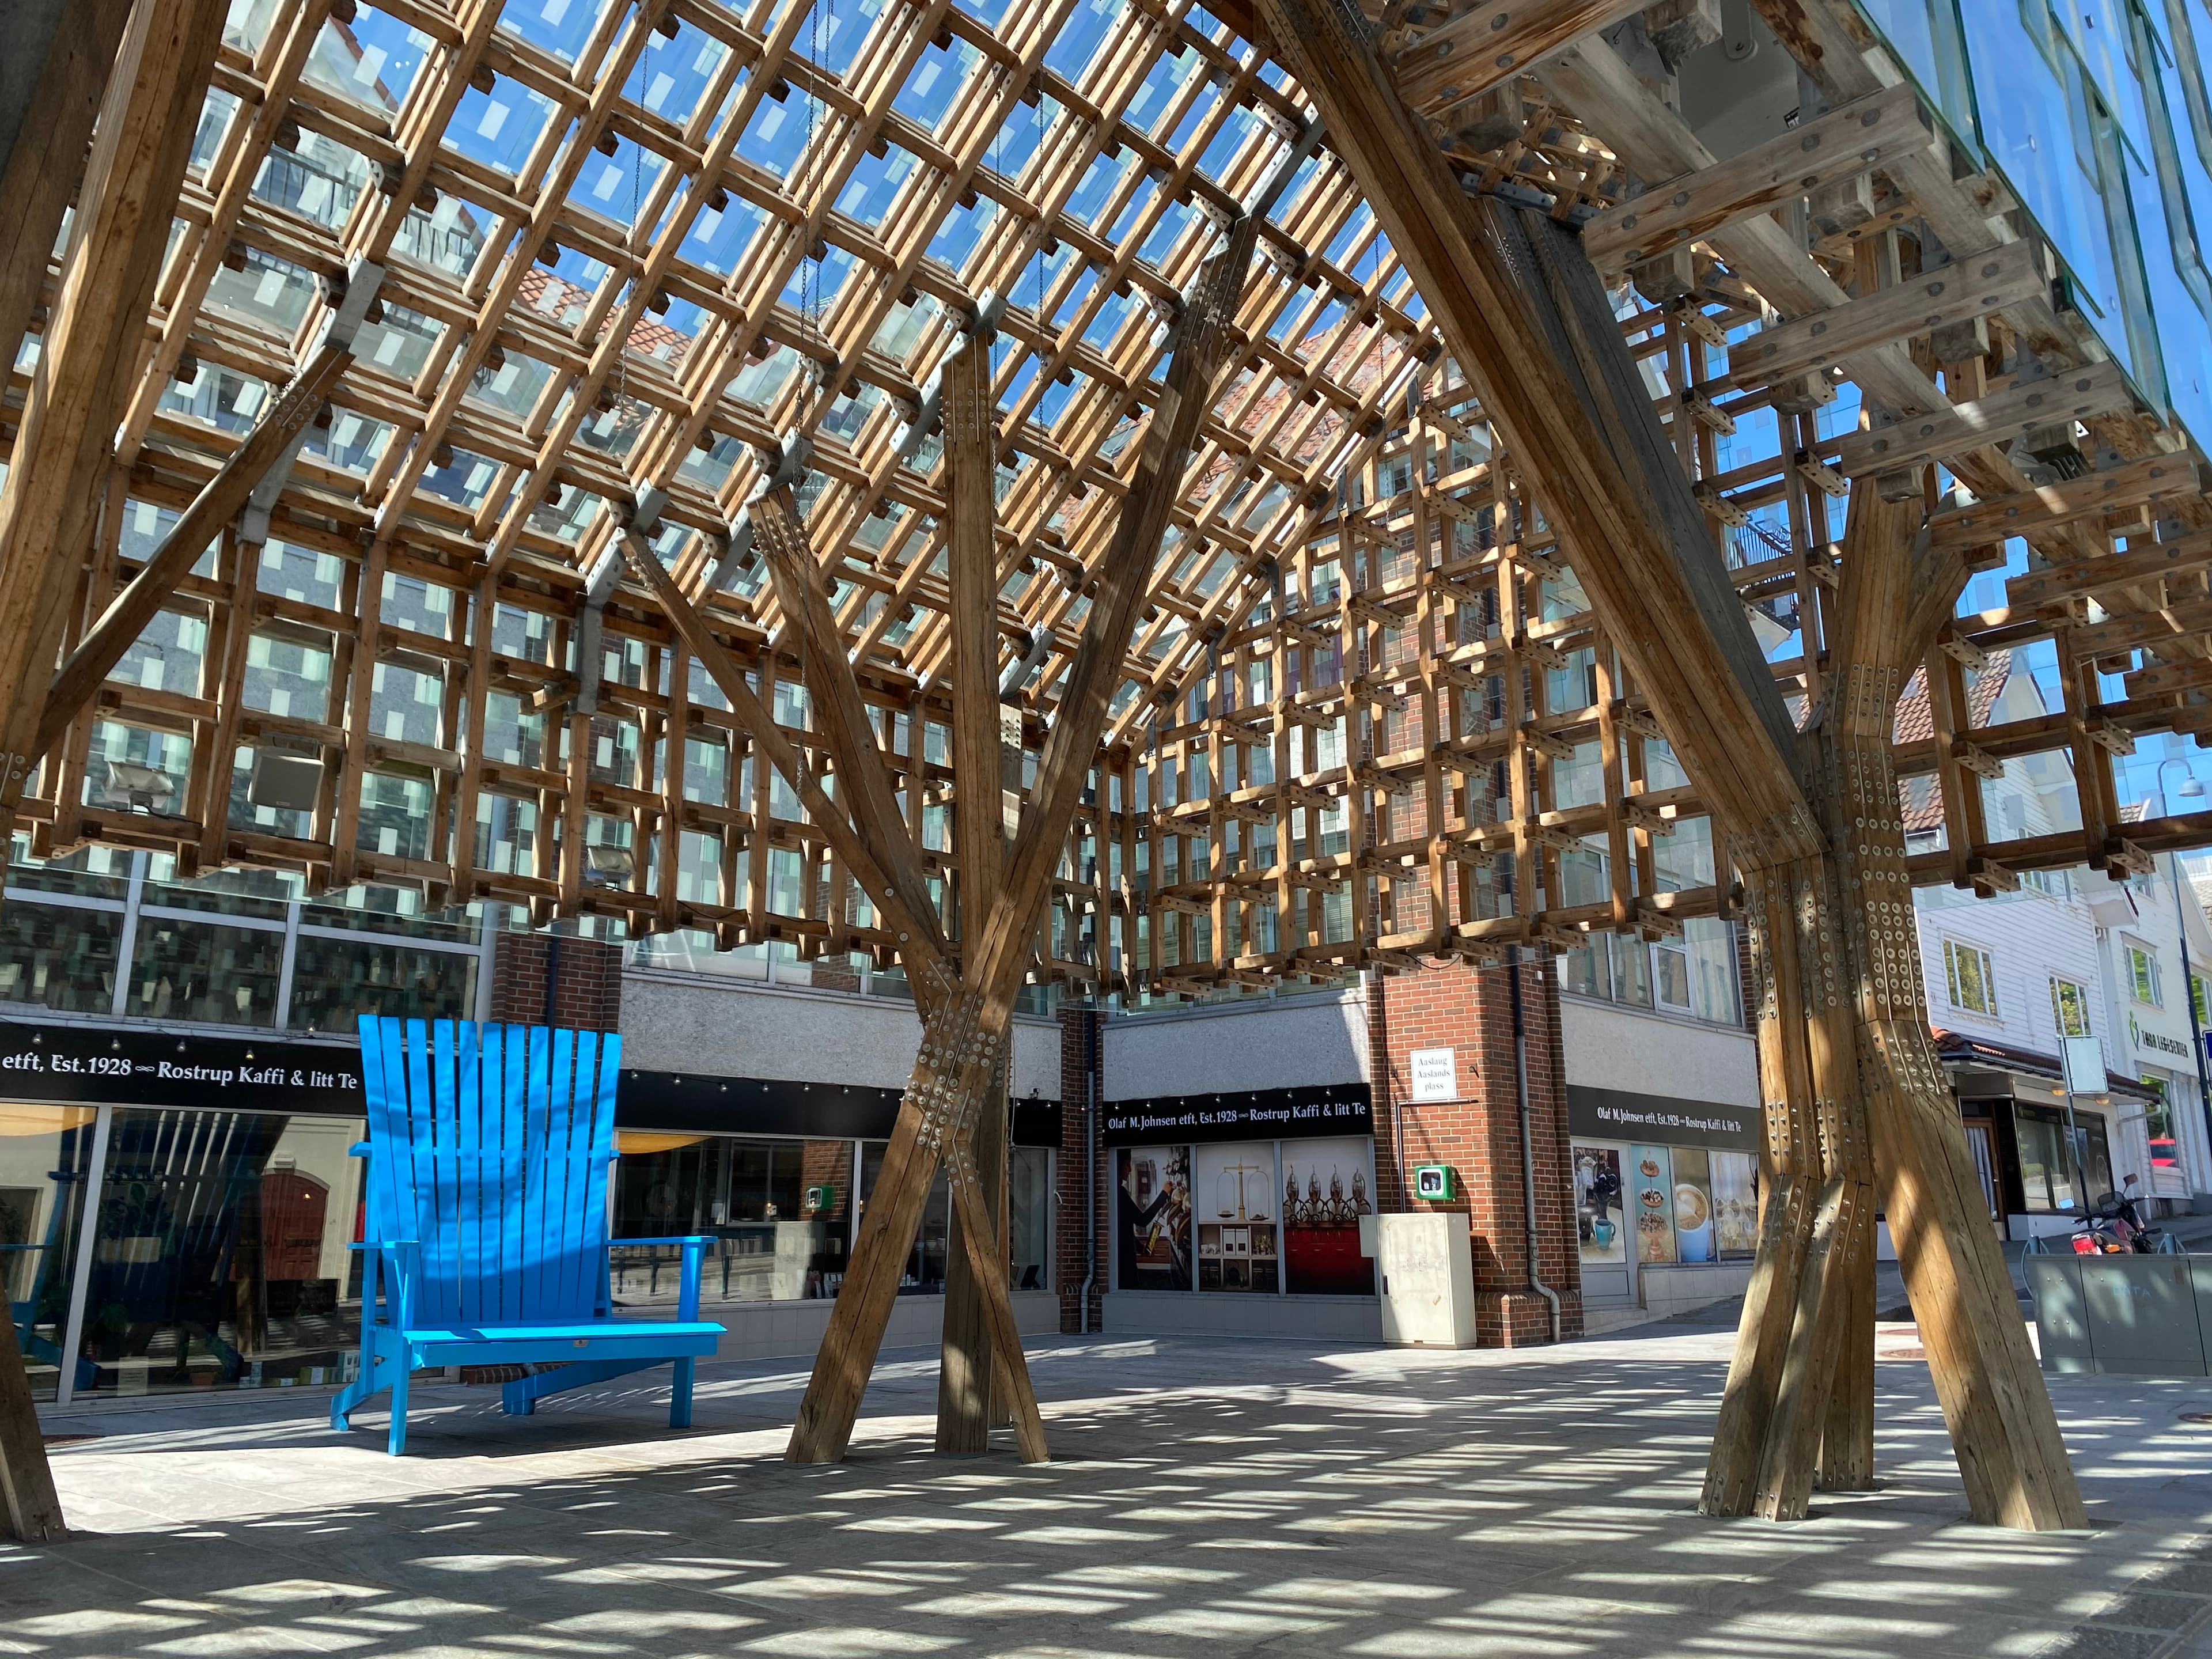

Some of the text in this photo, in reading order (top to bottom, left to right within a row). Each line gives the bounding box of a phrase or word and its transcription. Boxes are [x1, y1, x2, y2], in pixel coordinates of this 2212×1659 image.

[2, 1052, 44, 1072] etft,
[157, 1061, 233, 1086] Rostrup
[238, 1066, 285, 1085] Kaffi
[290, 1070, 304, 1086] &
[310, 1071, 334, 1088] litt
[338, 1073, 357, 1089] Te
[1418, 1058, 1447, 1066] Aaslaug
[1418, 1069, 1450, 1078] Aaslands
[1425, 1082, 1444, 1092] plass
[1108, 1117, 1127, 1129] Olaf
[1179, 1112, 1198, 1125] etft,
[1250, 1108, 1290, 1122] Rostrup
[1293, 1105, 1319, 1118] Kaffi
[1323, 1104, 1332, 1116] &
[1335, 1103, 1350, 1116] litt
[1352, 1102, 1366, 1115] Te
[1597, 1107, 1611, 1119] Olaf
[1685, 1116, 1707, 1132] Rostrup
[1707, 1118, 1721, 1130] Kaffi
[1722, 1119, 1727, 1131] &
[1734, 1121, 1741, 1132] Te
